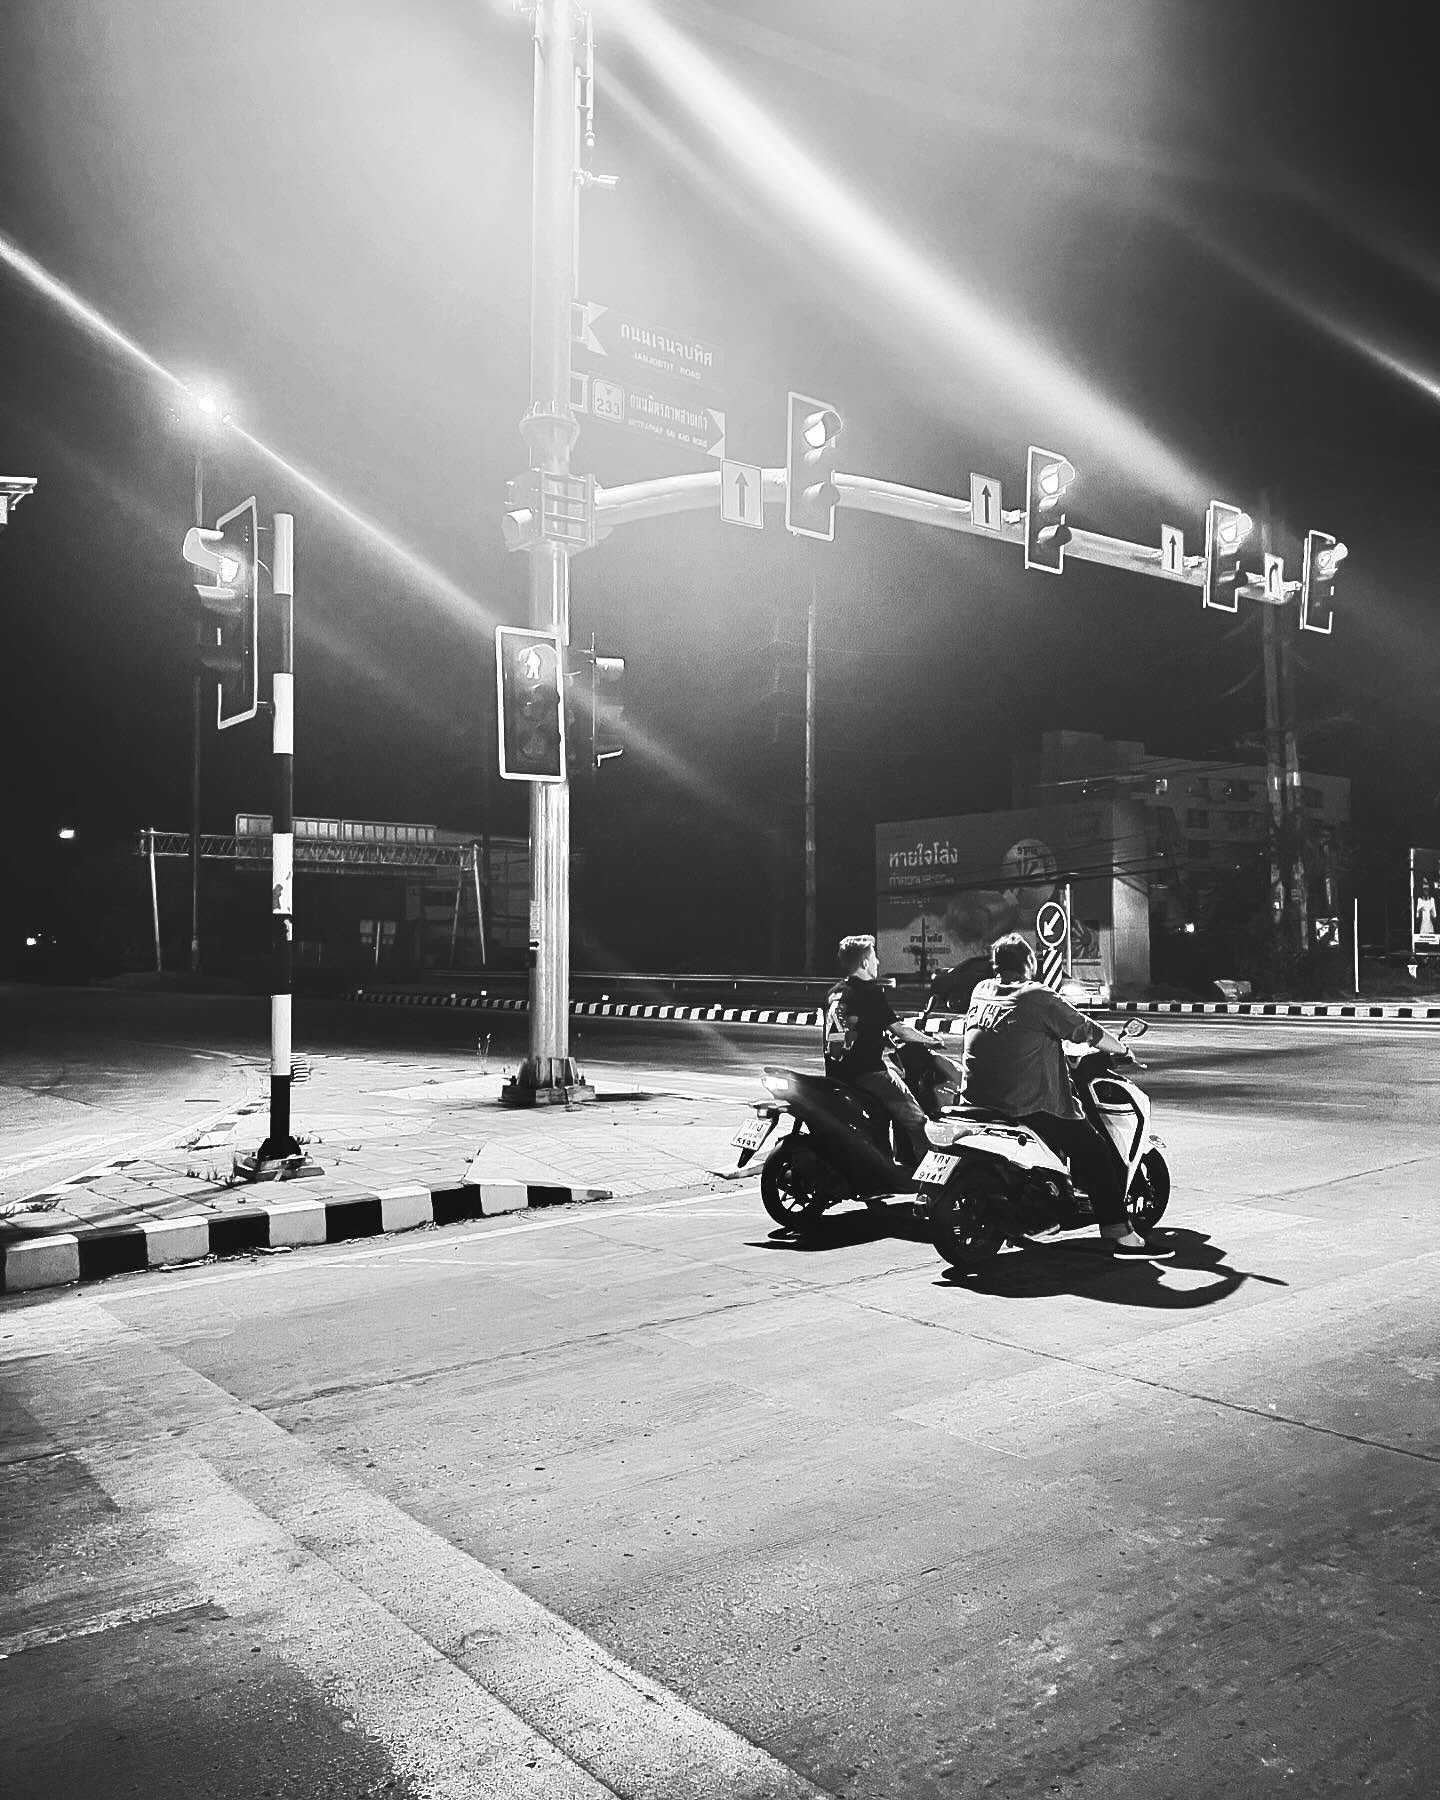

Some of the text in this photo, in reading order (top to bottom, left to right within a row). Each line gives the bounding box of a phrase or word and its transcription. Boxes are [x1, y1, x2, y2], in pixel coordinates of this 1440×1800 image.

[679, 366, 702, 380] ROAD
[596, 397, 620, 416] 233
[889, 840, 959, 868] หายใจโล่ง
[918, 1171, 943, 1182] 9141
